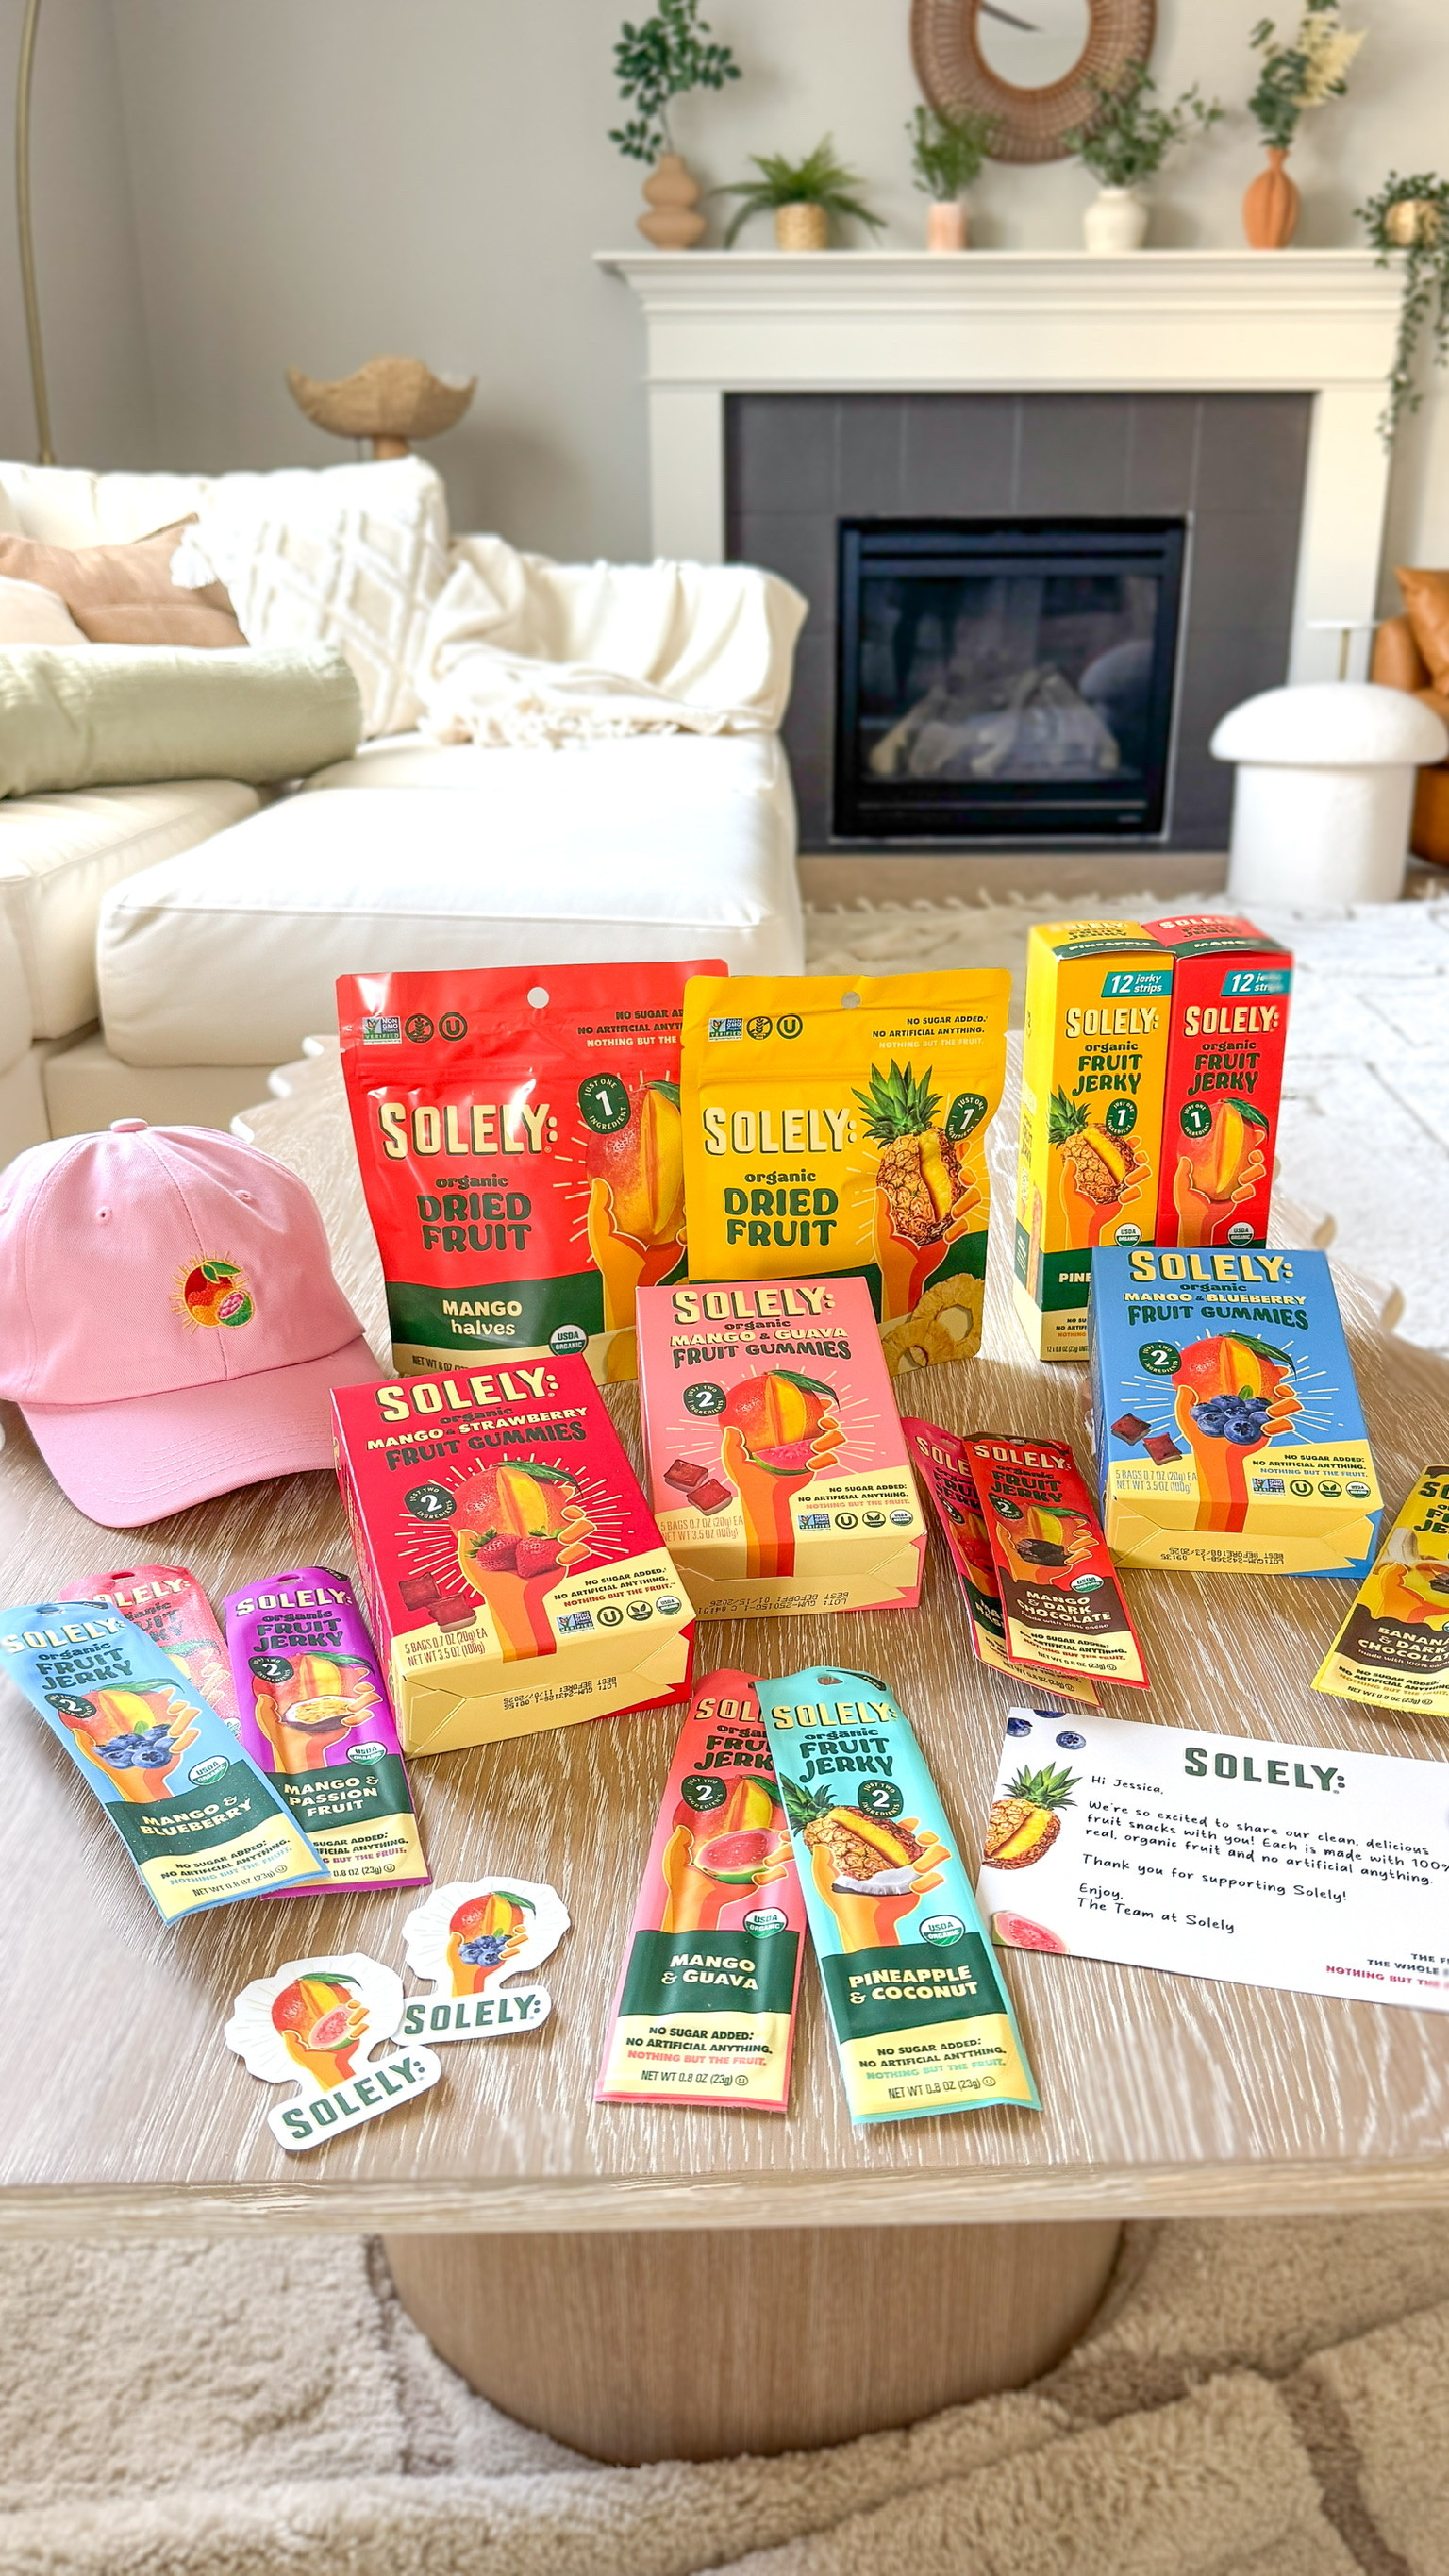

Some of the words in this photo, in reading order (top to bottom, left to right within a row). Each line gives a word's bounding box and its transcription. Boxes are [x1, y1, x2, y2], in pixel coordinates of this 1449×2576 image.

[1068, 941, 1151, 951] PINEAPPLE
[1111, 974, 1133, 994] 12
[1134, 983, 1162, 994] strips
[1136, 974, 1161, 984] jerky
[1231, 973, 1254, 993] 12
[596, 1024, 650, 1034] ARTIFICIAL
[923, 1016, 952, 1025] SUGAR
[937, 1027, 985, 1035] ANYTHING.
[1066, 1007, 1159, 1038] SOLELY:
[1184, 1006, 1279, 1037] SOLELY:
[587, 1038, 634, 1047] NOTHING
[637, 1036, 655, 1045] BUT
[1085, 1042, 1138, 1053] organic
[1202, 1041, 1256, 1051] organic
[1078, 1054, 1142, 1071] FRUIT
[1194, 1053, 1260, 1071] FRUIT
[1072, 1074, 1141, 1096] JERKY
[1188, 1072, 1258, 1096] JERKY
[379, 1102, 558, 1160] SOLELY:
[704, 1106, 858, 1155] SOLELY:
[436, 1174, 508, 1190] organic
[744, 1169, 816, 1185] organic
[417, 1193, 532, 1222] DRIED
[724, 1188, 839, 1217] DRIED
[422, 1224, 532, 1252] FRUIT
[726, 1219, 838, 1246] FRUIT
[1129, 1250, 1294, 1284] SOLELY:
[1180, 1282, 1247, 1293] organic
[442, 1299, 523, 1317] MANGO
[672, 1287, 836, 1326] SOLELY:
[1124, 1293, 1192, 1302] MANGO
[1207, 1293, 1307, 1305] BLUEBERRY
[450, 1319, 516, 1336] halves
[724, 1319, 791, 1330] organic
[1128, 1305, 1193, 1327] FRUIT
[1201, 1305, 1309, 1330] GUMMIES
[555, 1340, 583, 1350] ORGANIC
[558, 1331, 579, 1340] USDA
[671, 1331, 756, 1347] MANGO
[774, 1327, 848, 1341] GUAVA
[673, 1345, 739, 1369] FRUIT
[745, 1341, 852, 1361] GUMMIES
[376, 1367, 559, 1423] SOLELY:
[440, 1407, 513, 1424] organic
[367, 1428, 444, 1451] MANGO
[458, 1407, 588, 1435] STRAWBERRY
[386, 1440, 461, 1472] FRUIT
[467, 1422, 587, 1451] GUMMIES
[974, 1445, 1072, 1471] SOLELY:
[992, 1470, 1062, 1492] FRUIT
[996, 1465, 1054, 1479] organic
[991, 1481, 1063, 1503] JERKY
[236, 1588, 353, 1617] SOLELY:
[1026, 1590, 1091, 1604] MANGO
[1044, 1601, 1091, 1614] DARK
[262, 1610, 333, 1622] organic
[1017, 1599, 1112, 1623] CHOCOLATE
[0, 1617, 126, 1653] SOLELY:
[257, 1618, 341, 1637] FRUIT
[38, 1642, 111, 1661] organic
[253, 1631, 343, 1652] JERKY
[1396, 1640, 1447, 1654] DARK
[36, 1648, 124, 1676] FRUIT
[408, 1653, 424, 1667] NET
[424, 1651, 437, 1664] WT
[438, 1648, 450, 1661] 3.5
[450, 1647, 461, 1658] OZ
[461, 1643, 486, 1659] (100g)
[42, 1659, 133, 1691] JERKY
[772, 1701, 898, 1730] SOLELY:
[804, 1727, 878, 1741] organic
[799, 1737, 890, 1759] FRUIT
[799, 1755, 893, 1783] JERKY
[1185, 1747, 1345, 1792] SOLELY:
[284, 1777, 360, 1796] MANGO
[365, 1775, 379, 1785] &
[1091, 1776, 1106, 1786] Hi
[289, 1787, 377, 1807] PASSION
[140, 1798, 252, 1836] BLUEBERRY
[142, 1803, 220, 1826] MANGO
[223, 1795, 238, 1805] &
[307, 1799, 364, 1818] FRUIT
[1089, 1801, 1129, 1815] We're
[1136, 1809, 1150, 1817] so
[1157, 1813, 1208, 1828] excited
[1215, 1818, 1229, 1829] to
[1237, 1822, 1278, 1835] share
[1285, 1831, 1310, 1839] our
[1366, 1839, 1429, 1856] delicious
[1088, 1814, 1121, 1827] fruit
[1129, 1820, 1176, 1833] snacks
[1184, 1829, 1217, 1840] with
[1224, 1834, 1254, 1846] you!
[1263, 1838, 1297, 1851] Each
[1305, 1844, 1316, 1855] is
[1324, 1848, 1362, 1862] made
[1370, 1853, 1405, 1867] with
[1124, 1833, 1177, 1848] organic
[1185, 1841, 1220, 1855] fruit
[1228, 1850, 1255, 1863] and
[1262, 1854, 1278, 1864] no
[1286, 1857, 1353, 1873] artificial
[1361, 1867, 1433, 1886] anything.
[1083, 1853, 1130, 1870] Thank
[1138, 1865, 1164, 1876] you
[1171, 1867, 1194, 1879] for
[1202, 1874, 1286, 1895] supporting
[1293, 1884, 1346, 1903] Solely!
[1077, 1897, 1107, 1911] The
[1115, 1902, 1154, 1918] Team
[1161, 1913, 1177, 1923] at
[1186, 1915, 1235, 1934] Solely
[670, 1953, 756, 1972] MANGO
[661, 1971, 677, 1984] &
[682, 1969, 758, 1990] GUAVA
[848, 1965, 972, 1989] PINEAPPLE
[1325, 1965, 1385, 1981] NOTHING
[1389, 1975, 1412, 1984] BUT
[850, 1991, 866, 2005] &
[871, 1981, 978, 2001] COCONUT
[404, 1993, 541, 2035] SOLELY:
[282, 2056, 425, 2140] SOLELY:
[888, 2087, 905, 2099] NET
[908, 2085, 924, 2096] WT
[942, 2081, 957, 2092] OZ
[958, 2079, 981, 2092] (23g)
